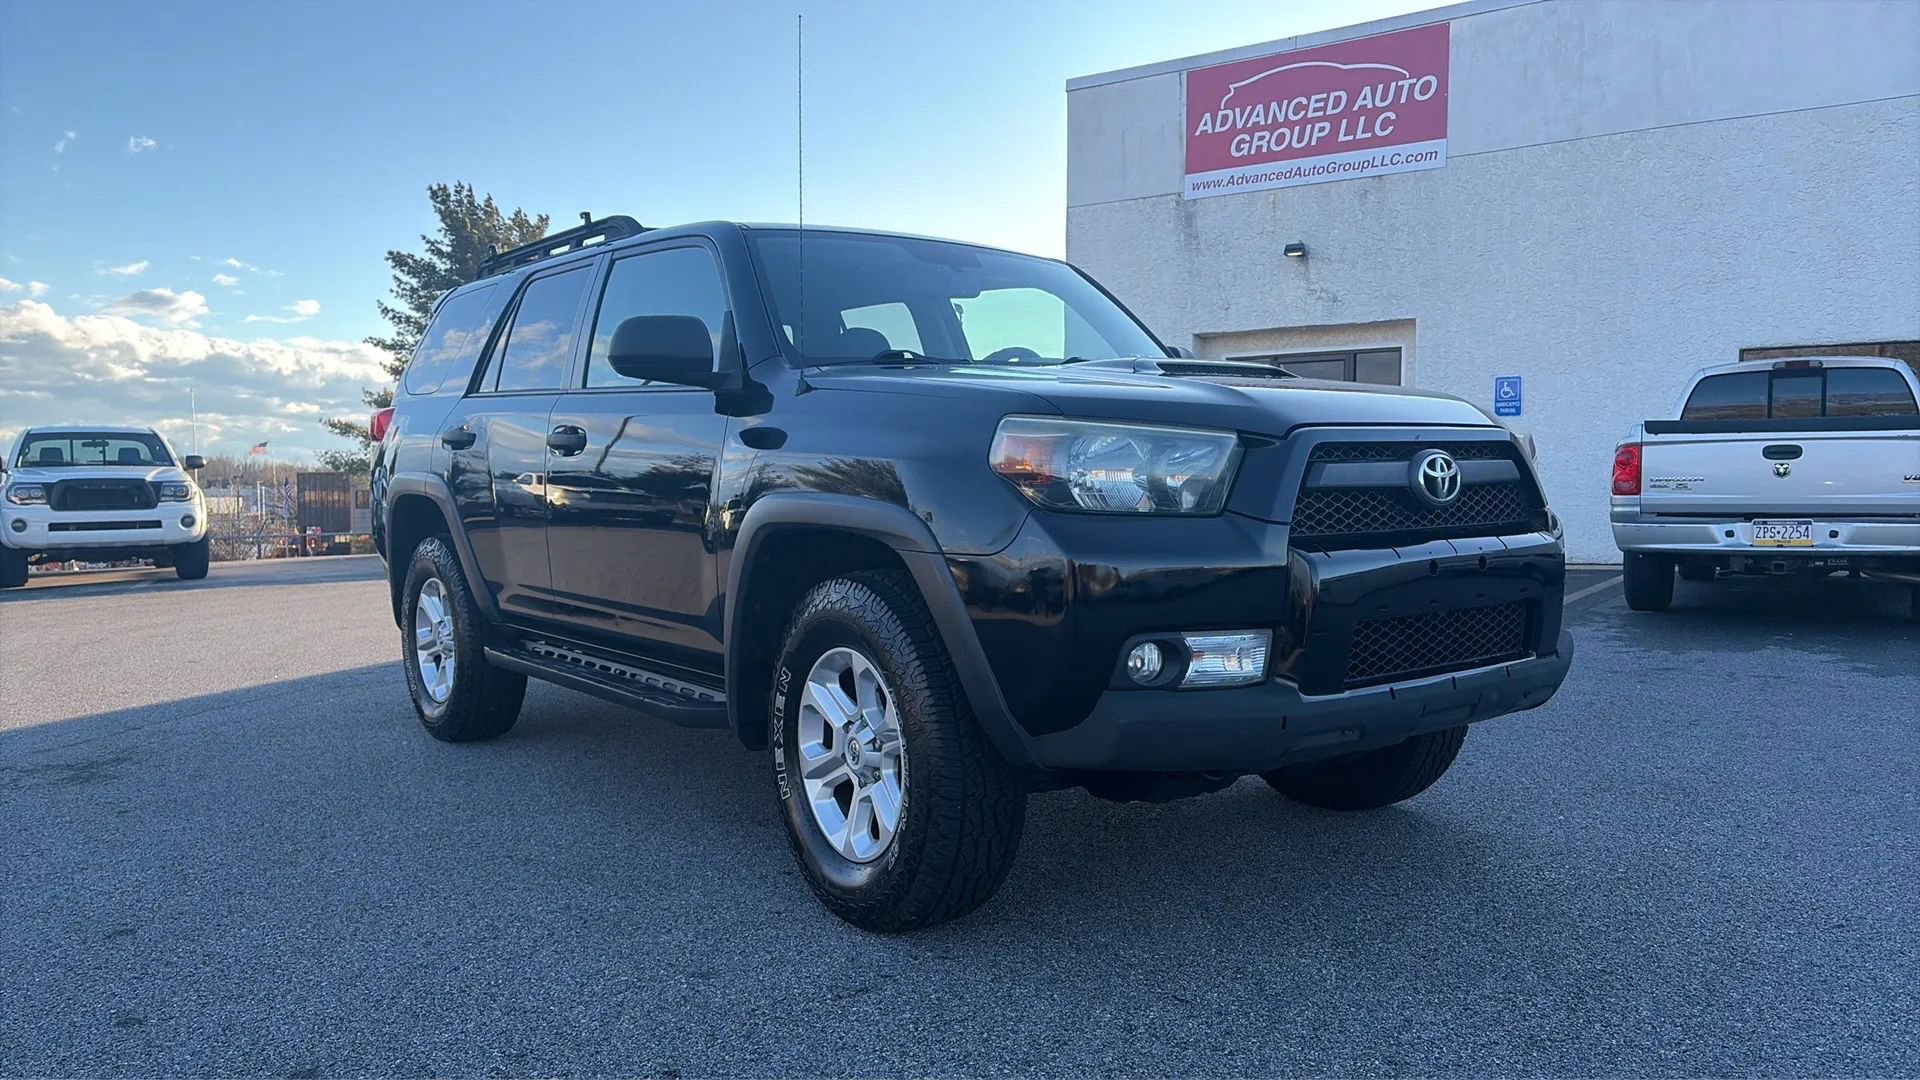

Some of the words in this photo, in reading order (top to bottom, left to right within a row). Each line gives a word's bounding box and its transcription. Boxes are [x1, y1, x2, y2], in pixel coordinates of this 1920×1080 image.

[1195, 90, 1348, 136] ADVANCED
[1353, 75, 1438, 112] AUTO
[1230, 121, 1331, 158] GROUP
[1338, 111, 1396, 142] LLC
[1192, 149, 1438, 191] www.AdvancedAutoGroupLLC.com
[773, 666, 792, 800] NEXEN
